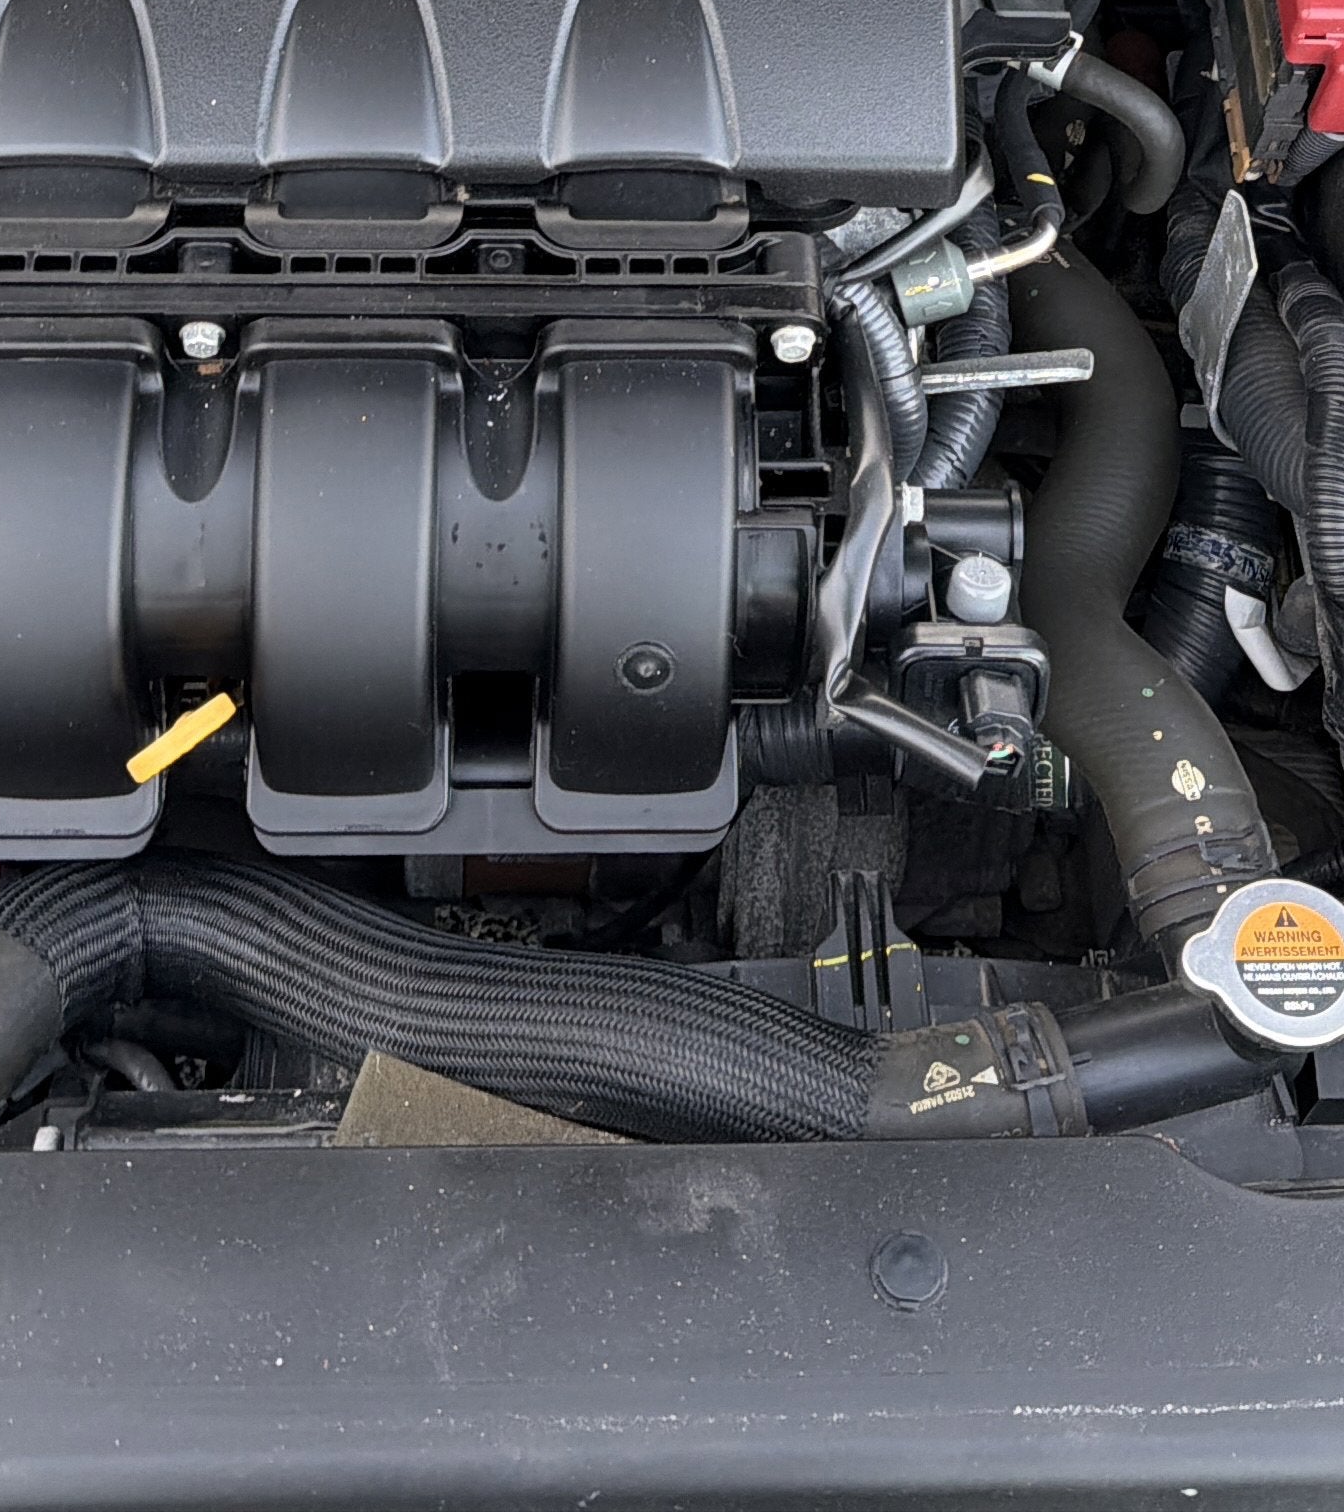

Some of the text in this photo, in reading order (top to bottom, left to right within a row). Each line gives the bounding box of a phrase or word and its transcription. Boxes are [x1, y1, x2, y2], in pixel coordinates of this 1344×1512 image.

[1254, 930, 1322, 943] WARNING
[1240, 945, 1341, 958] AVERTISSEMENT
[1243, 962, 1271, 971] NEVER
[1271, 962, 1296, 970] OPEN
[1296, 962, 1322, 970] WHEN
